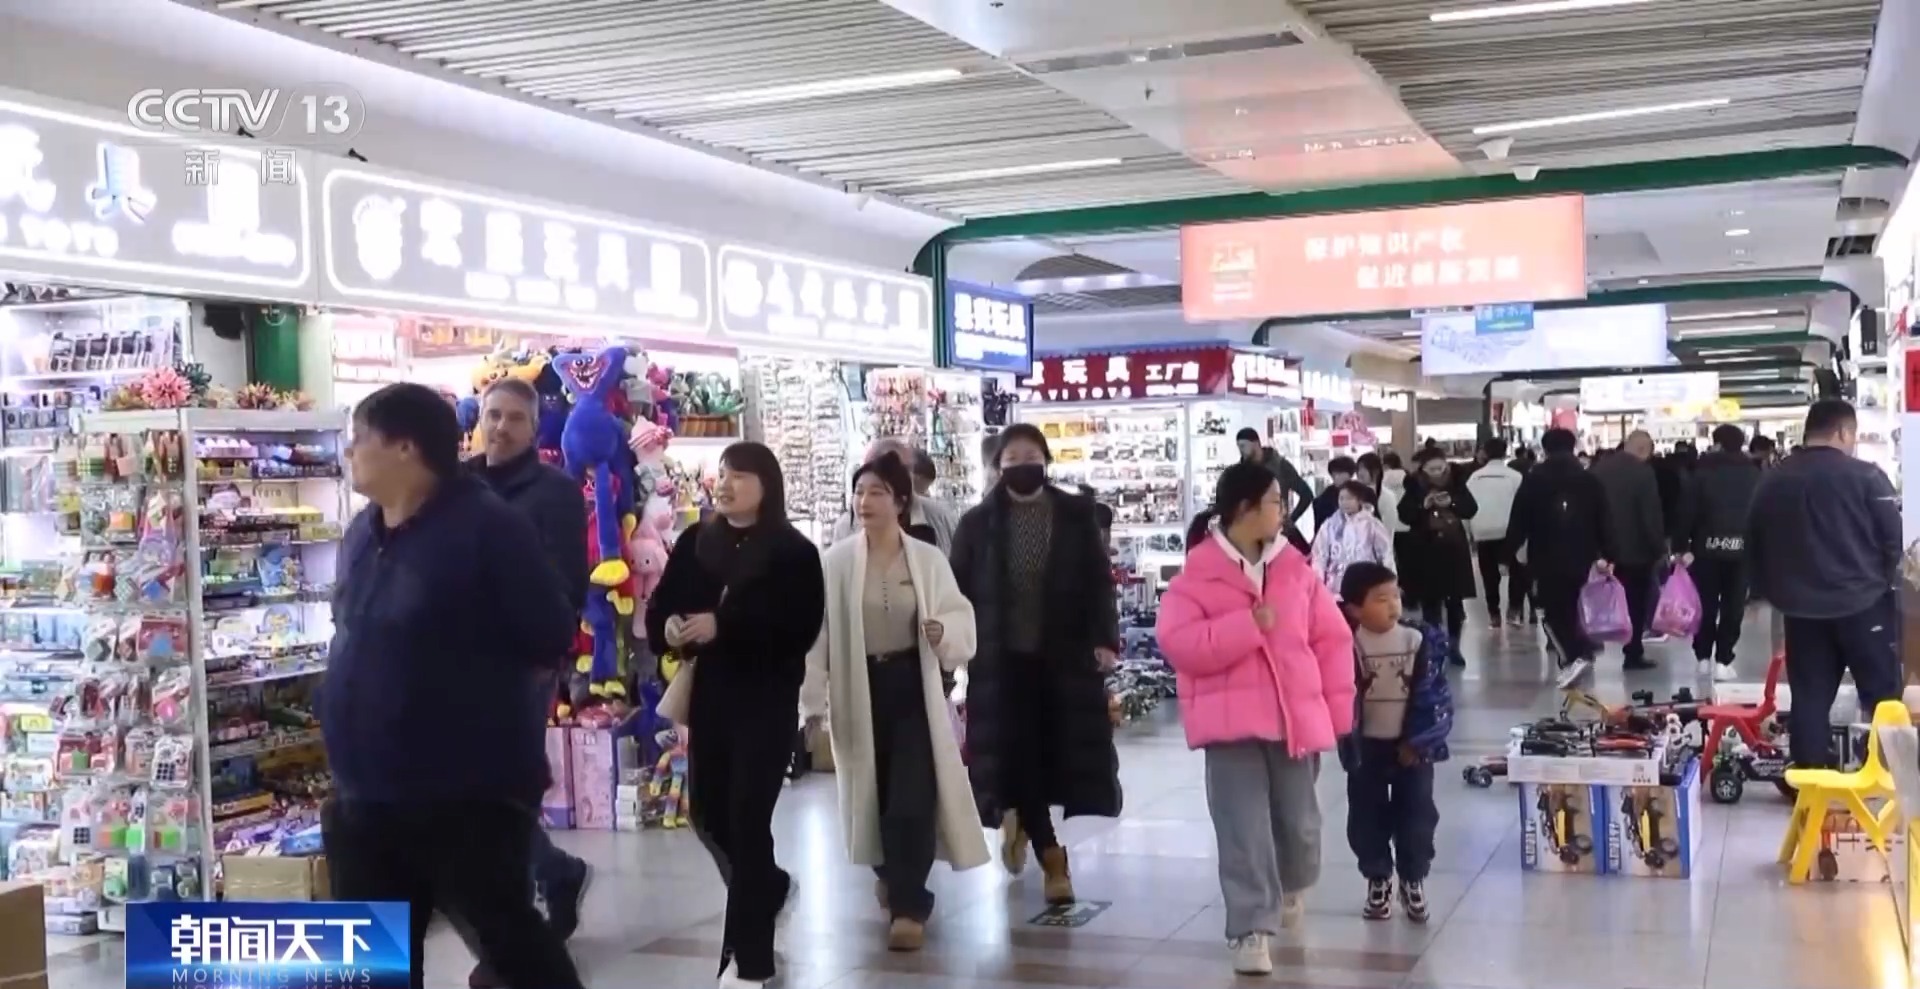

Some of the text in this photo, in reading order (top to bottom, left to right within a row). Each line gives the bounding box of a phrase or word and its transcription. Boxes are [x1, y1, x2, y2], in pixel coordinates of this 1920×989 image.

[1304, 227, 1466, 262] 保护知识产权
